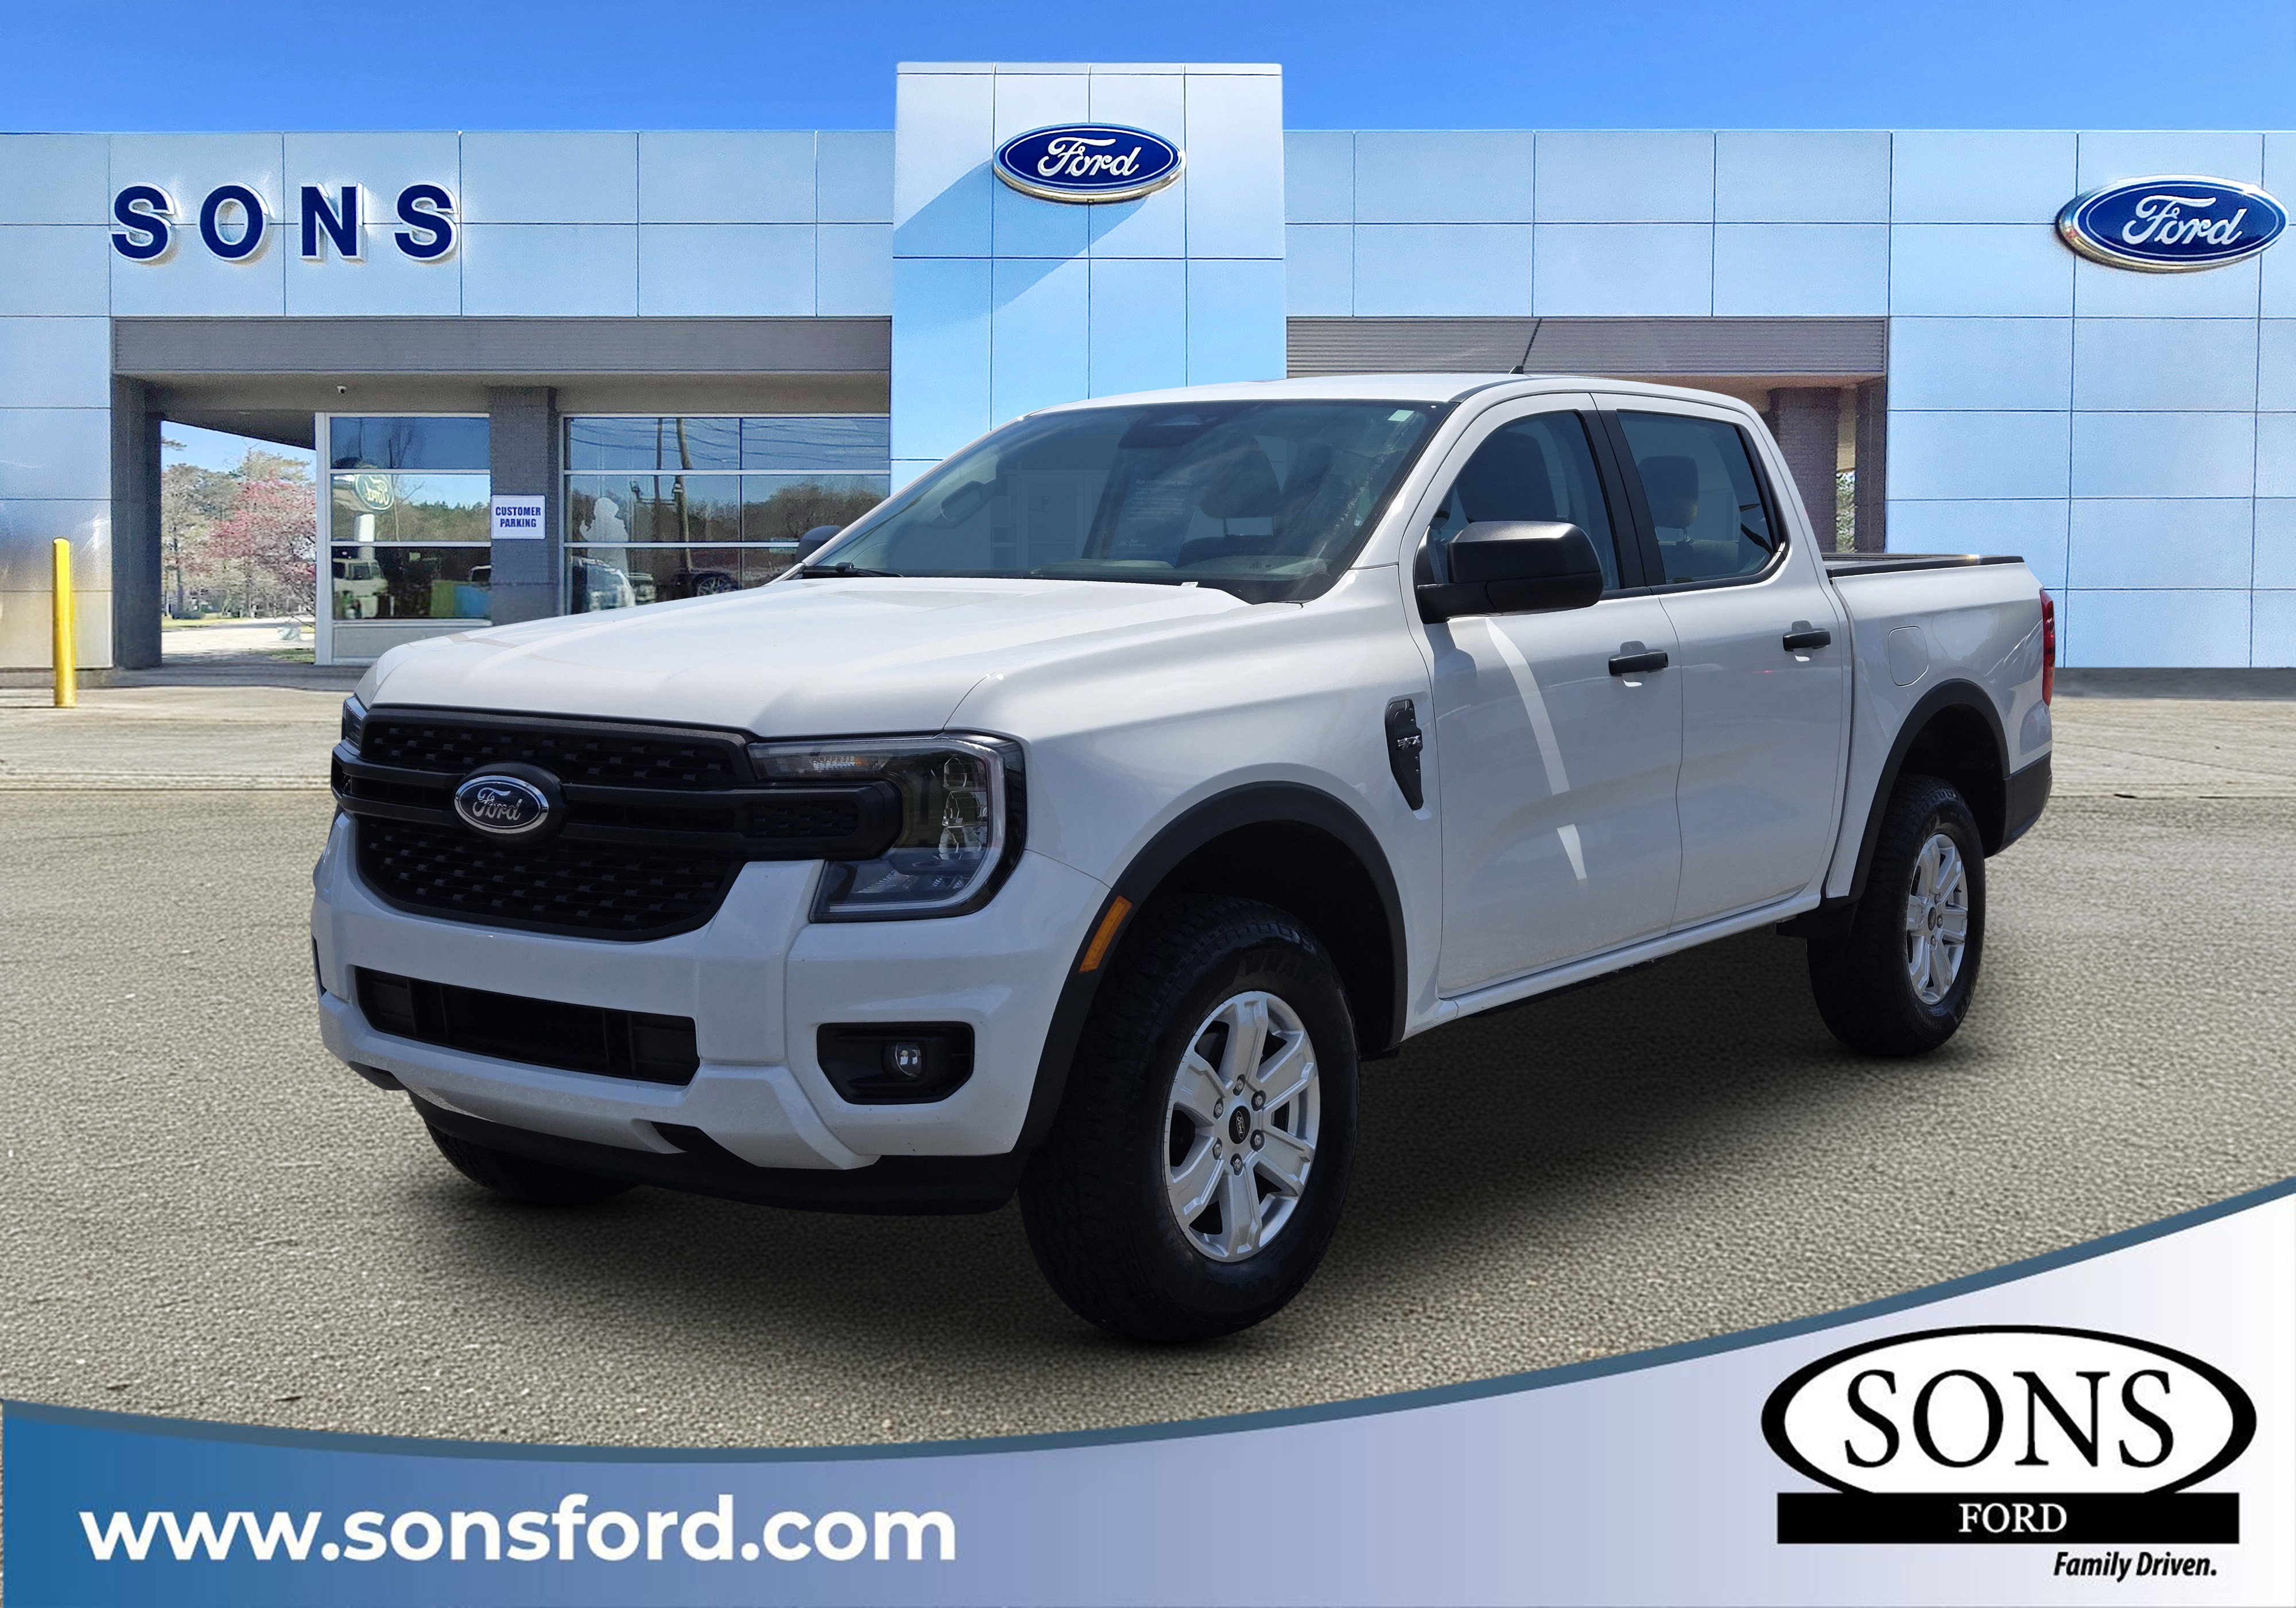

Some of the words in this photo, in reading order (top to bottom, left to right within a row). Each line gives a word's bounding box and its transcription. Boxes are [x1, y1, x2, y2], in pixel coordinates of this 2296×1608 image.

[1037, 137, 1142, 177] Ford
[110, 182, 459, 262] SONS
[2122, 195, 2247, 246] Ford
[495, 506, 541, 516] CUSTOMER
[500, 518, 537, 527] PARKING
[472, 787, 523, 821] Ford
